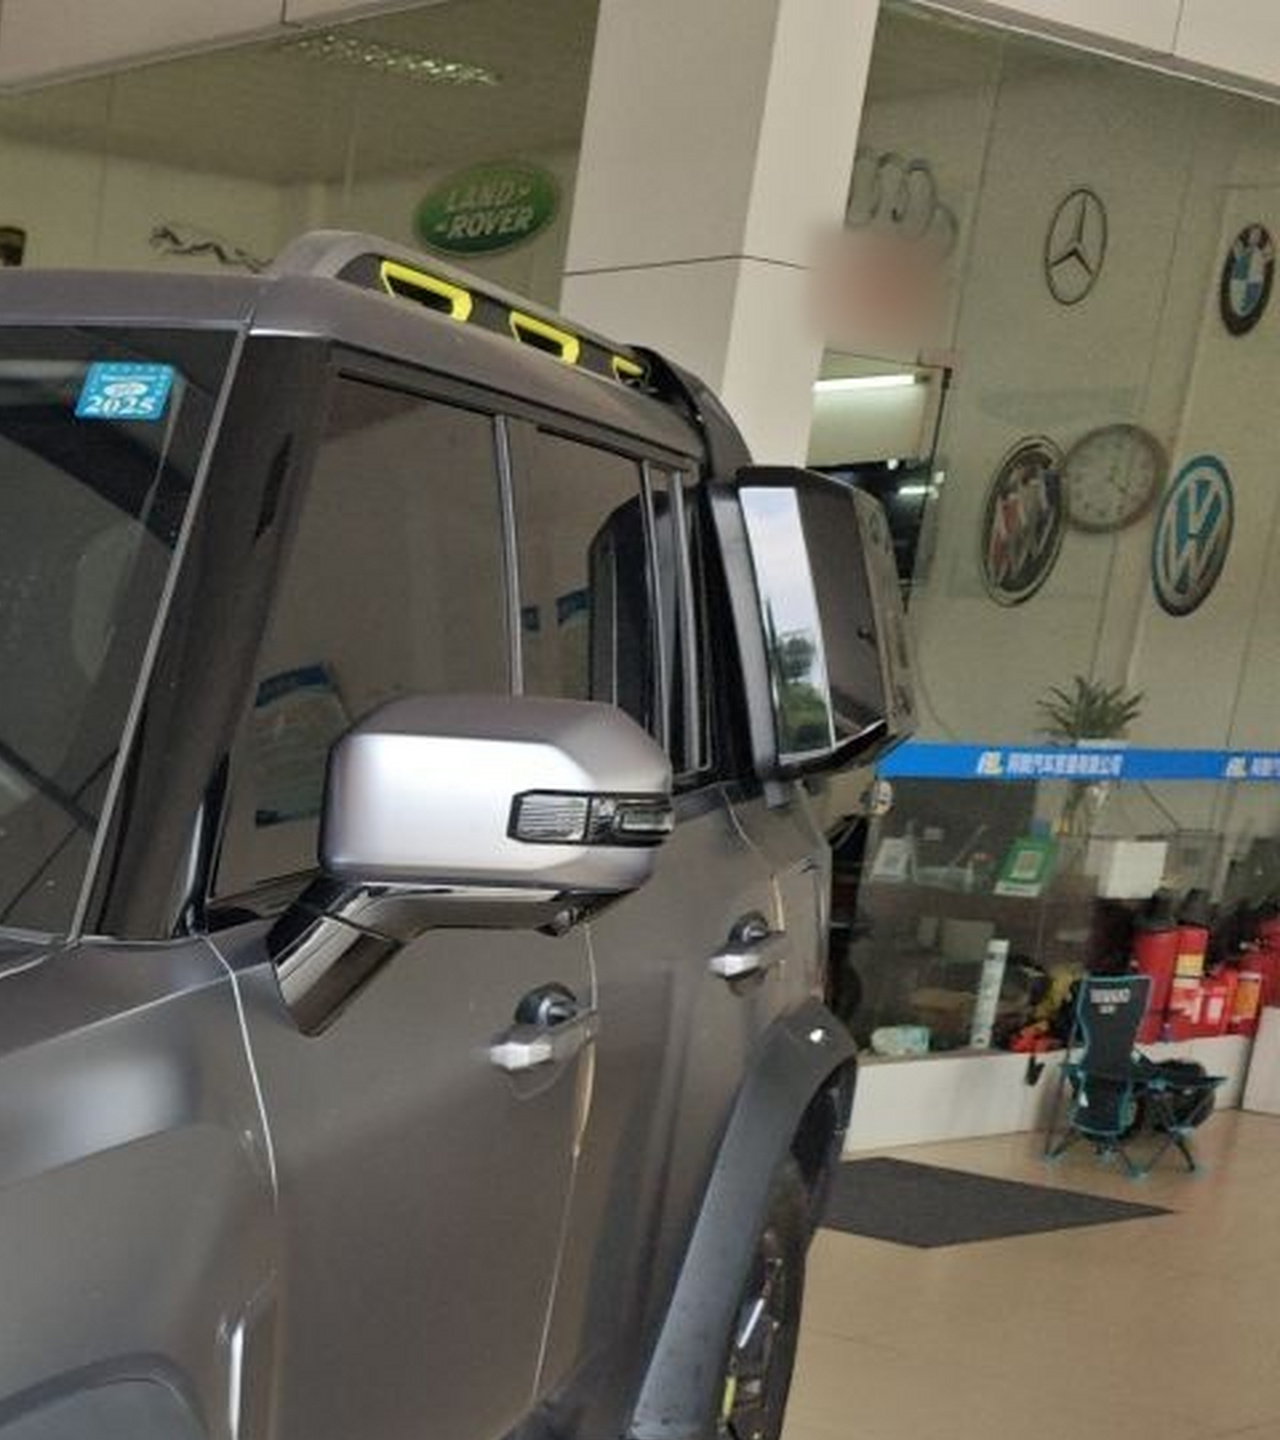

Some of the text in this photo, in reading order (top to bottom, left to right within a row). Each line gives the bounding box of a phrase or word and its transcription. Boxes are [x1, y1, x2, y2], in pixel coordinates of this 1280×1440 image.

[446, 181, 516, 213] LAND
[446, 204, 534, 240] ROVER
[83, 395, 155, 416] 2025
